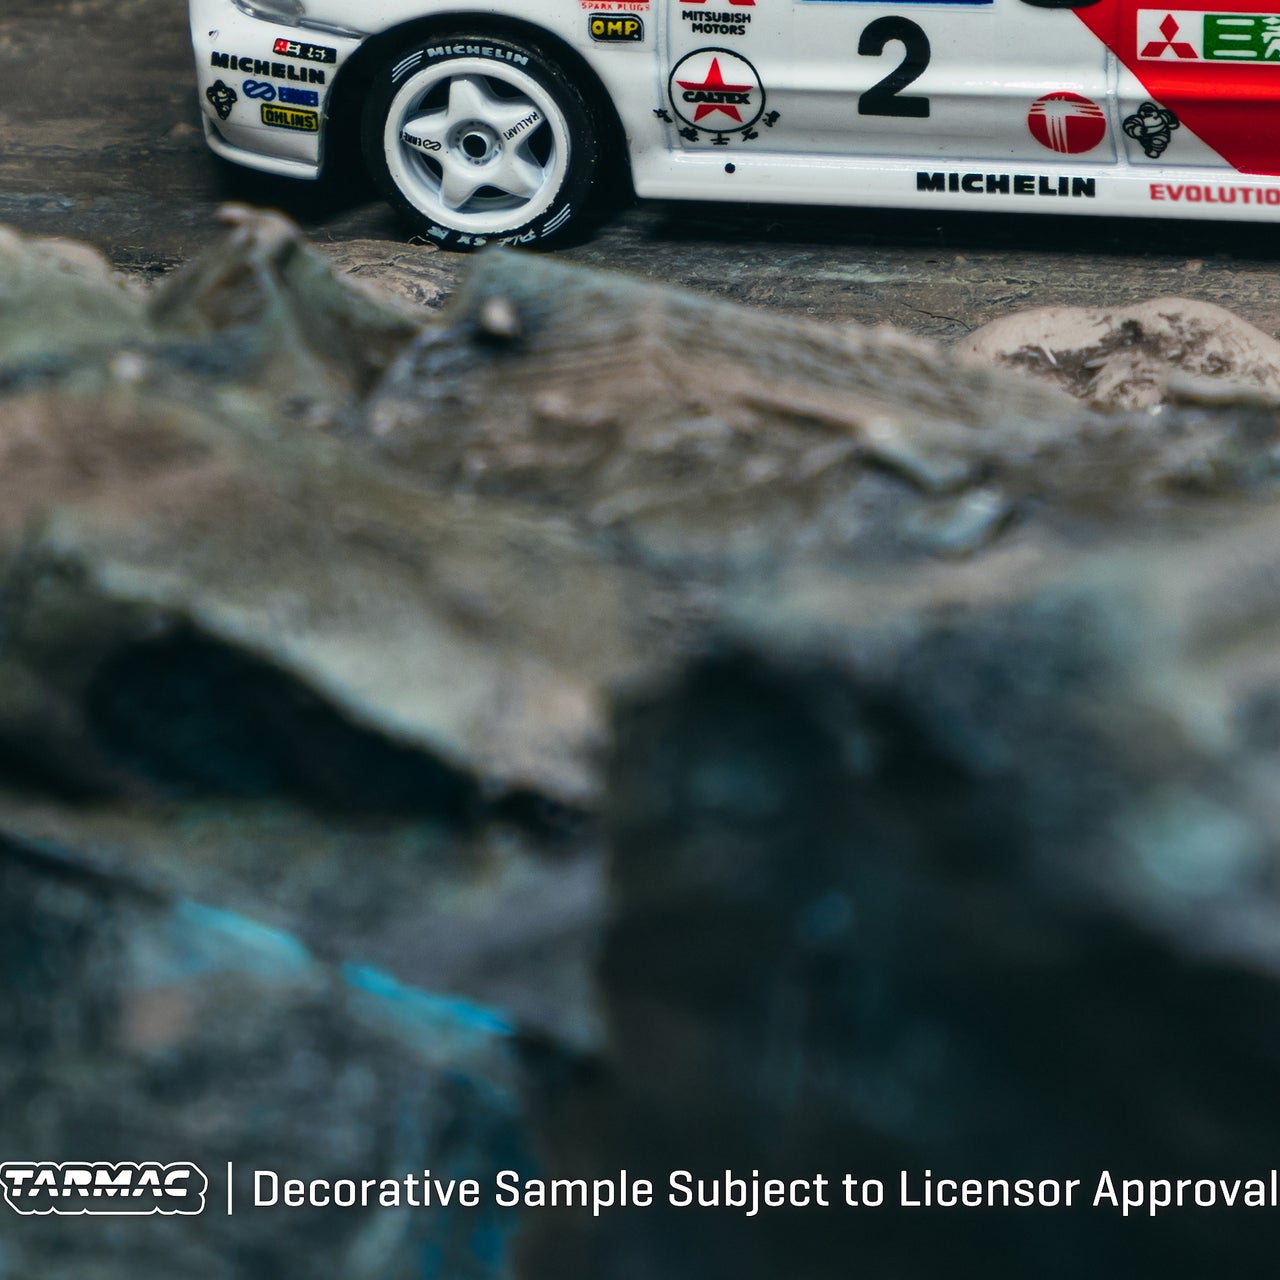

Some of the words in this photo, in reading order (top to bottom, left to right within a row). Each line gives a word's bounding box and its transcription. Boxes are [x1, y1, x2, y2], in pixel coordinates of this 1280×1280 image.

[581, 2, 613, 11] SPARK
[691, 23, 746, 35] MOTORS
[210, 51, 325, 85] MICHELIN
[426, 45, 529, 67] MICHELIN
[857, 15, 931, 118] 2
[682, 91, 751, 105] CALTEX
[503, 111, 540, 141] RALLIART
[916, 171, 1096, 199] MICHELIN
